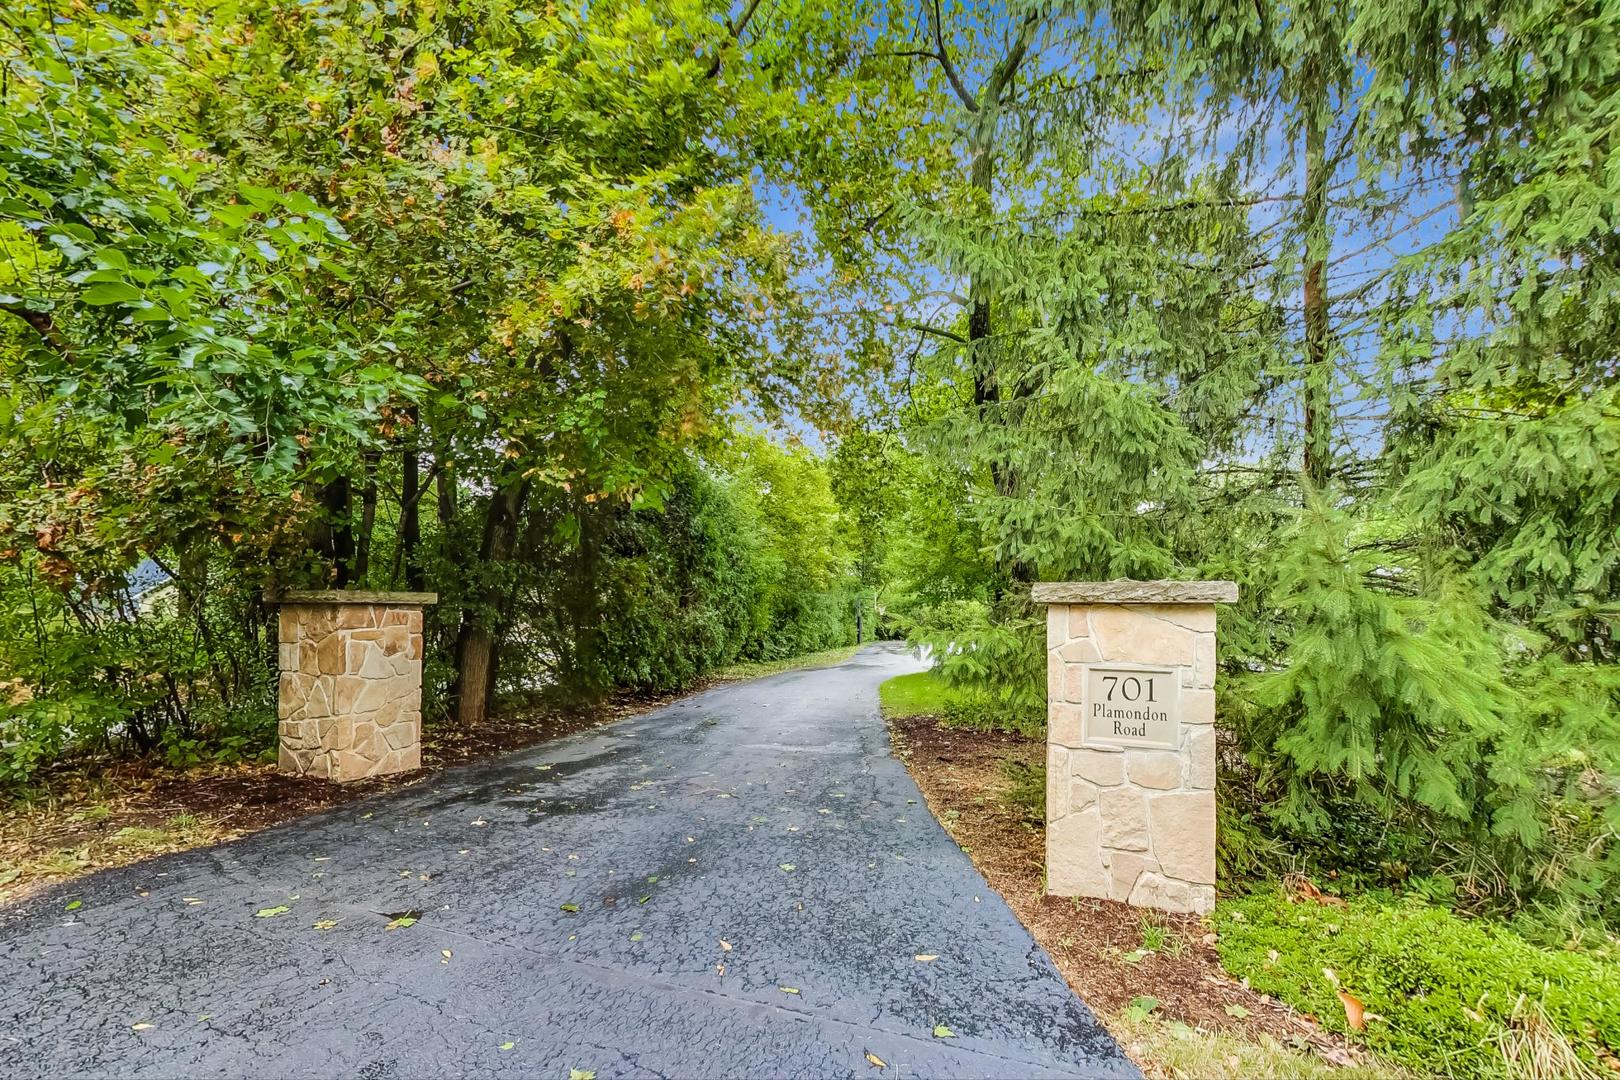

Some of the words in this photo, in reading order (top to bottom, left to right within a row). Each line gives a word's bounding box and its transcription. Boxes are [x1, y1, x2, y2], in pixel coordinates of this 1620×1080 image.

[1102, 676, 1158, 702] 701
[1093, 703, 1168, 721] Plamondon
[1113, 720, 1146, 737] Road
